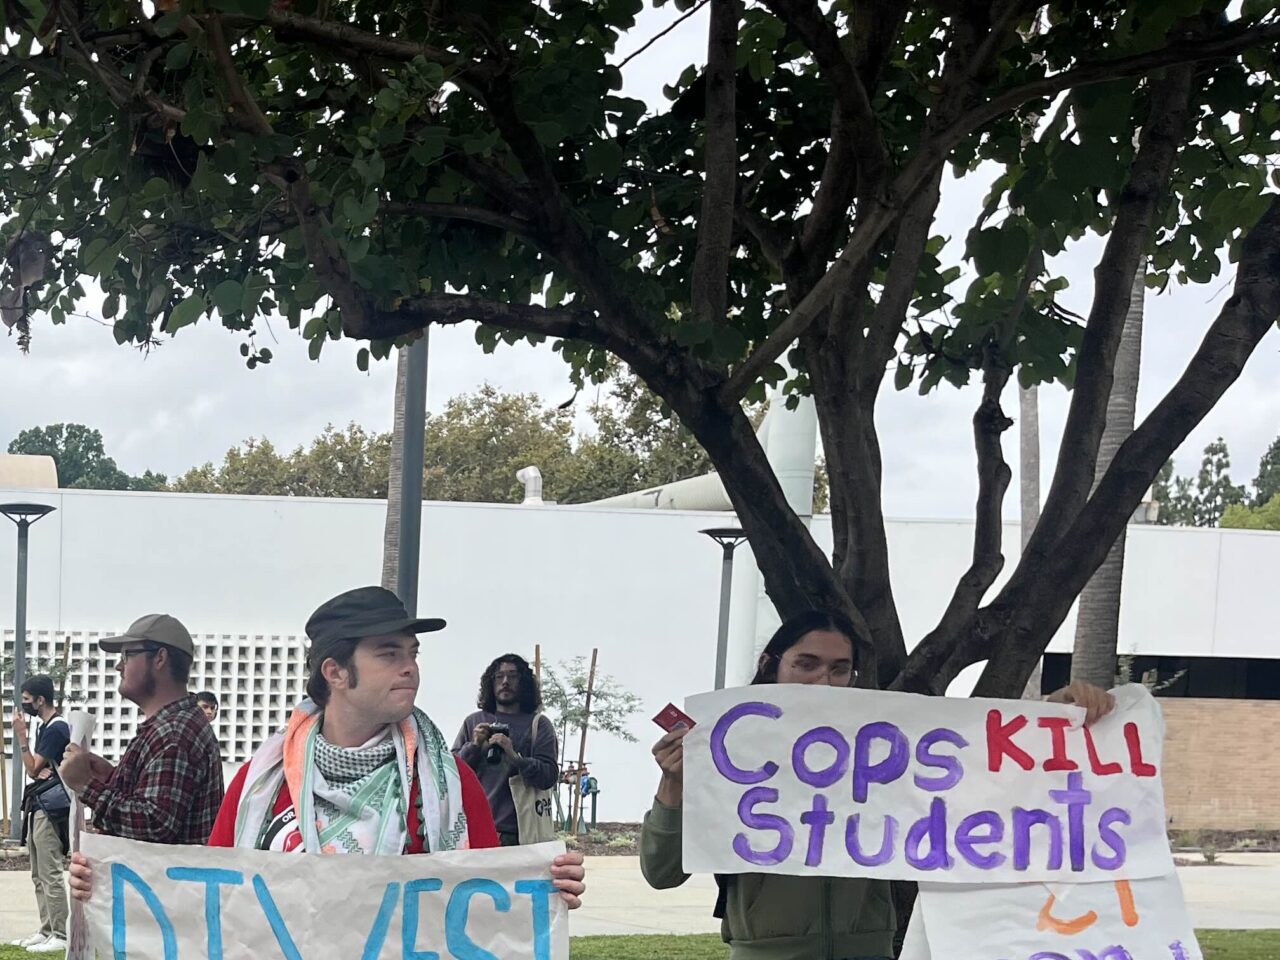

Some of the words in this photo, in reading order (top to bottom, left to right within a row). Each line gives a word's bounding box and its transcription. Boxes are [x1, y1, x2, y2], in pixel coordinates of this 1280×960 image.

[710, 701, 968, 803] Cops
[985, 708, 1157, 778] KILL
[732, 771, 1131, 873] Students
